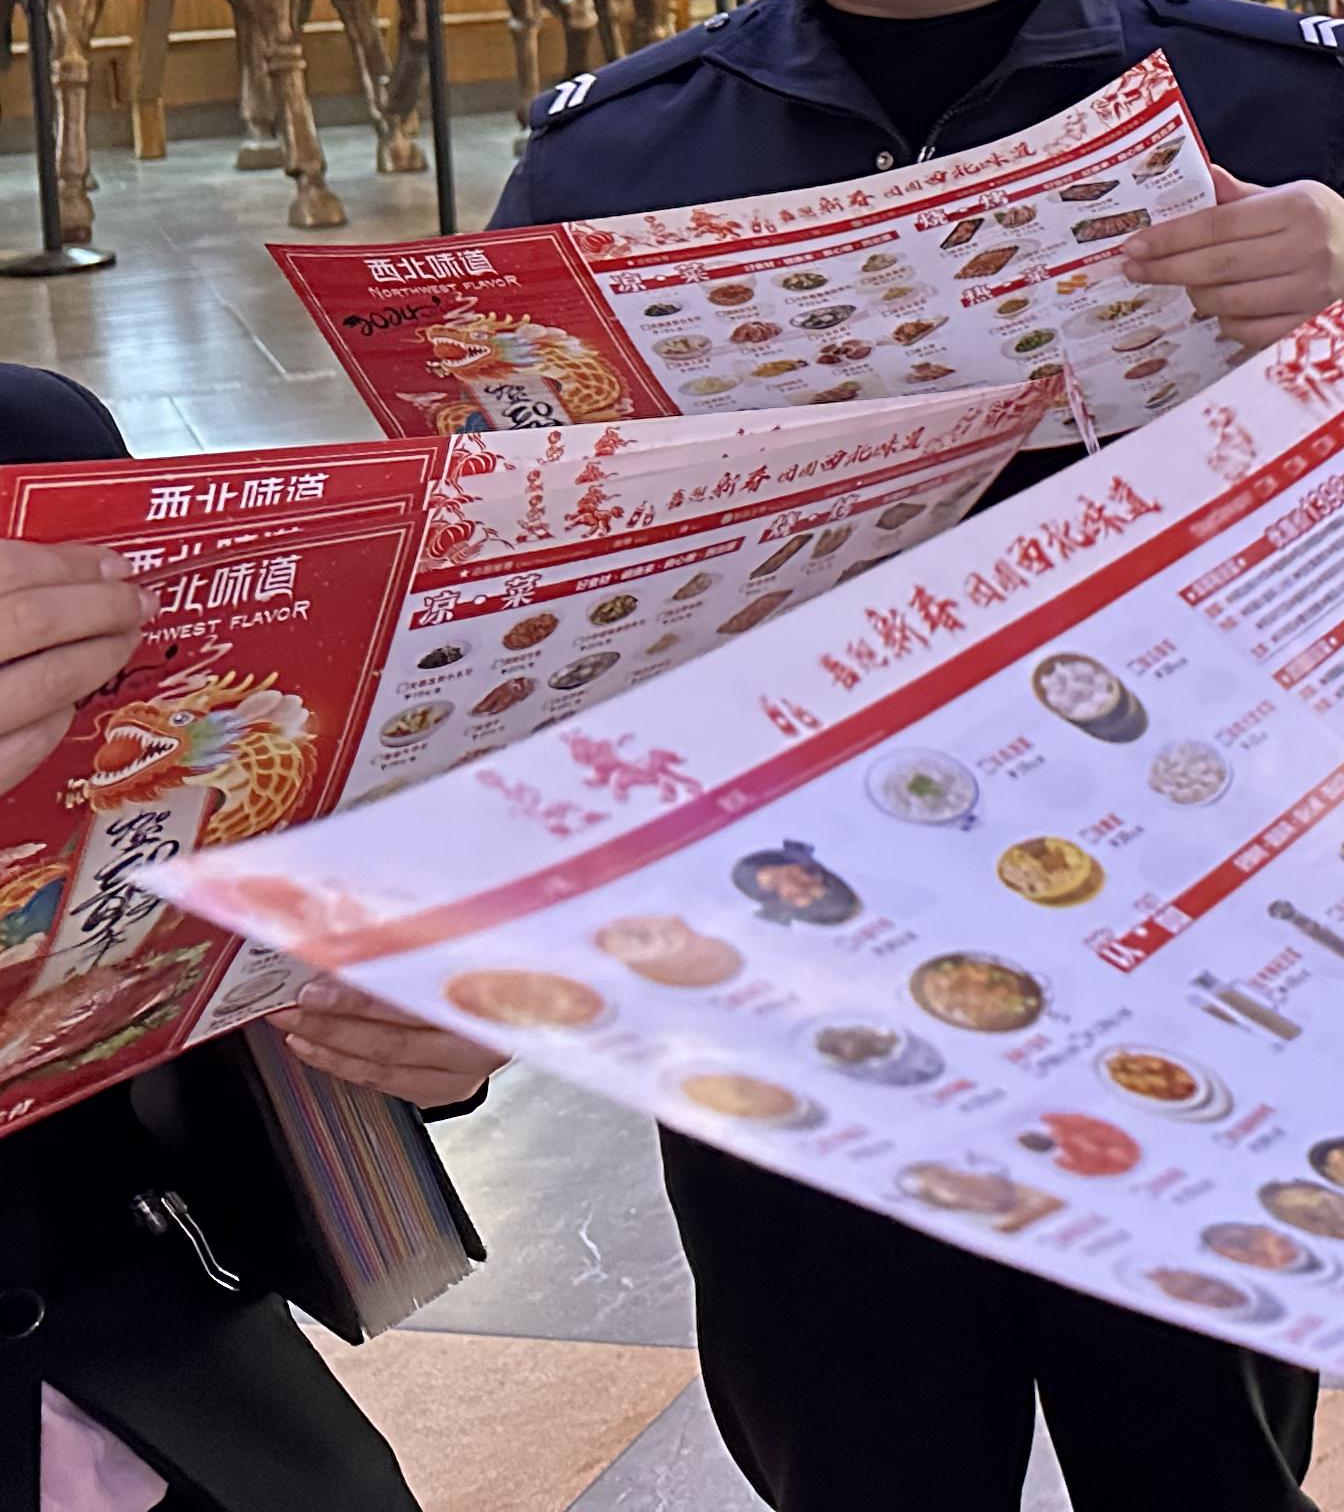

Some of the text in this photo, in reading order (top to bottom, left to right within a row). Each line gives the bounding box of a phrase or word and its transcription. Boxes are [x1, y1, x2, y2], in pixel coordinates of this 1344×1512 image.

[363, 249, 498, 284] 西北味道
[146, 472, 330, 520] 西北味道
[229, 600, 311, 630] FLAVOR
